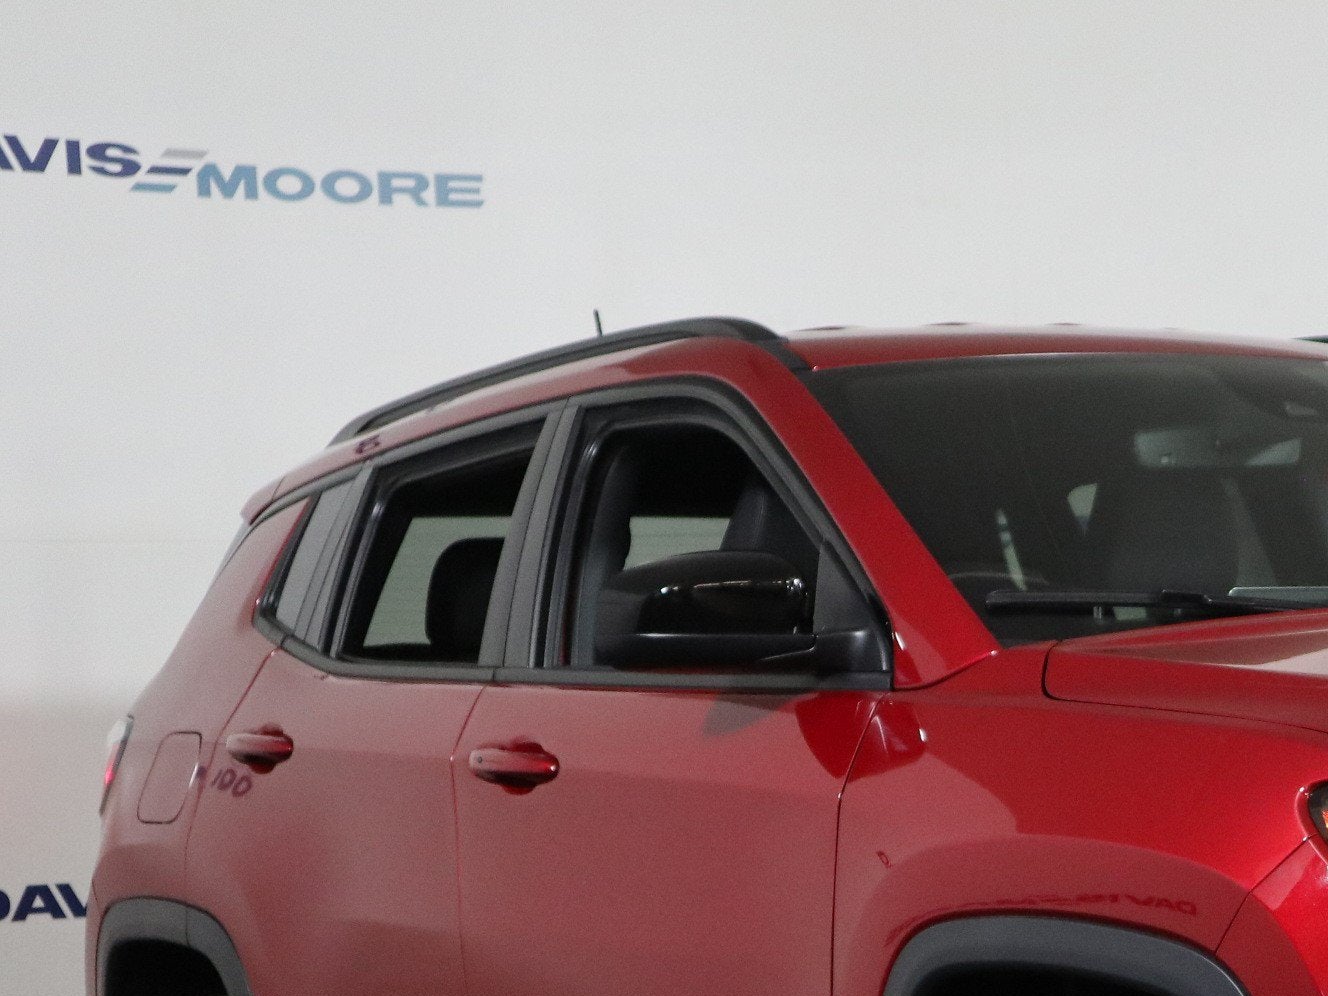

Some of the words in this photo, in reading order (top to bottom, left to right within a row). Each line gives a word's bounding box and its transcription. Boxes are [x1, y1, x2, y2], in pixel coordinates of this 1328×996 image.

[0, 134, 142, 178] VIS
[197, 163, 485, 208] MOORE
[0, 884, 87, 921] AV
